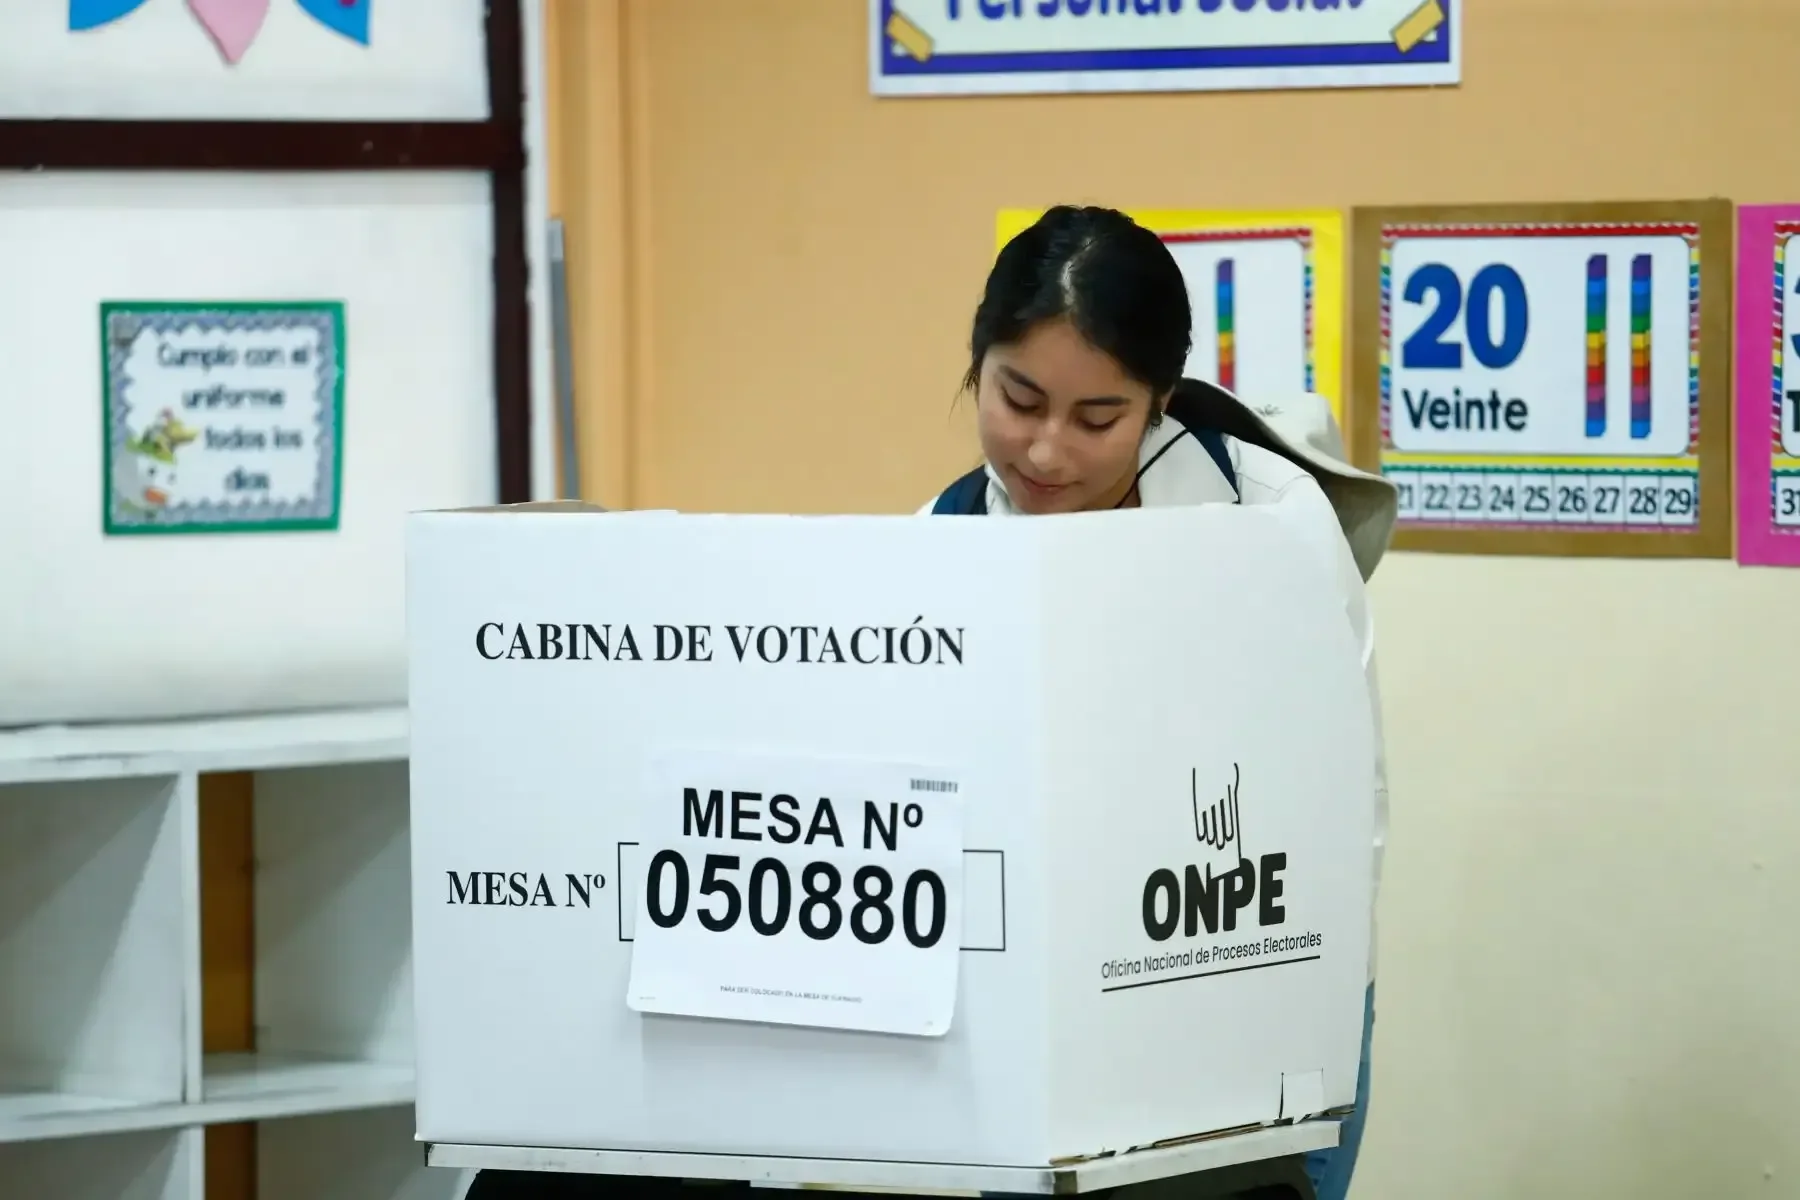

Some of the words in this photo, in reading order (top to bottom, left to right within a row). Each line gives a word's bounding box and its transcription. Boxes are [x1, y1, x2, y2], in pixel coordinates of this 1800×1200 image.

[1402, 262, 1528, 369] 20
[182, 384, 285, 408] uniforme
[1402, 387, 1528, 431] Veinte
[205, 427, 265, 449] todos
[1424, 485, 1450, 510] 22
[1457, 485, 1482, 511] 23
[1490, 485, 1515, 512] 24
[1524, 485, 1551, 512] 25
[1559, 486, 1587, 513] 26
[1595, 487, 1620, 514] 27
[1630, 487, 1657, 515] 28
[1665, 488, 1692, 516] 29
[475, 622, 643, 661] CABINA
[653, 624, 713, 662] DE
[724, 616, 965, 665] VOTACIÓN
[683, 787, 845, 848] MESA
[446, 870, 557, 907] MESA
[646, 849, 947, 949] 050880
[1142, 852, 1287, 942] ONPE
[1101, 958, 1141, 979] Oficina
[1144, 948, 1193, 973] Nacional
[1195, 947, 1210, 963] de
[1212, 942, 1261, 963] Procesos
[1263, 931, 1322, 955] Electorales
